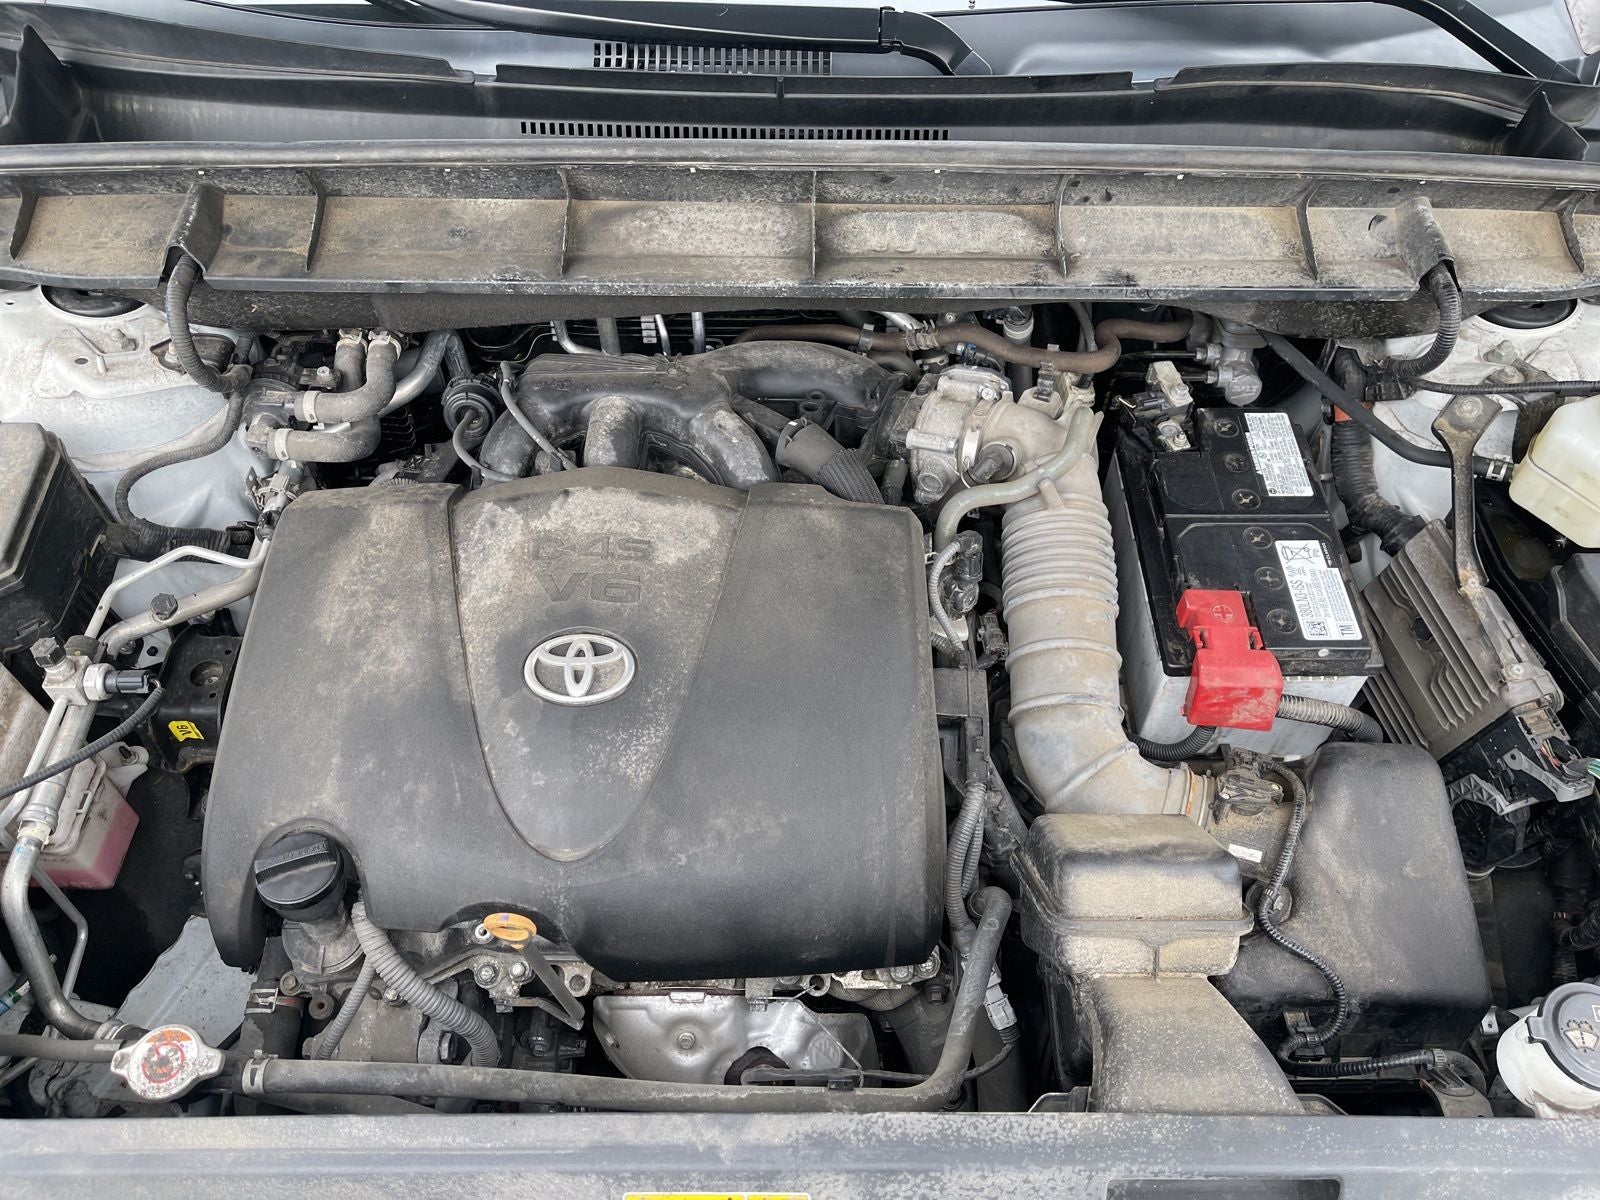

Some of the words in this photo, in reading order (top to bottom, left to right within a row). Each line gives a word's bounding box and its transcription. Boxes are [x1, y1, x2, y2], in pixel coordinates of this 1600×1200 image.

[539, 572, 641, 603] V6
[1339, 624, 1355, 636] TM
[176, 724, 193, 736] V6
